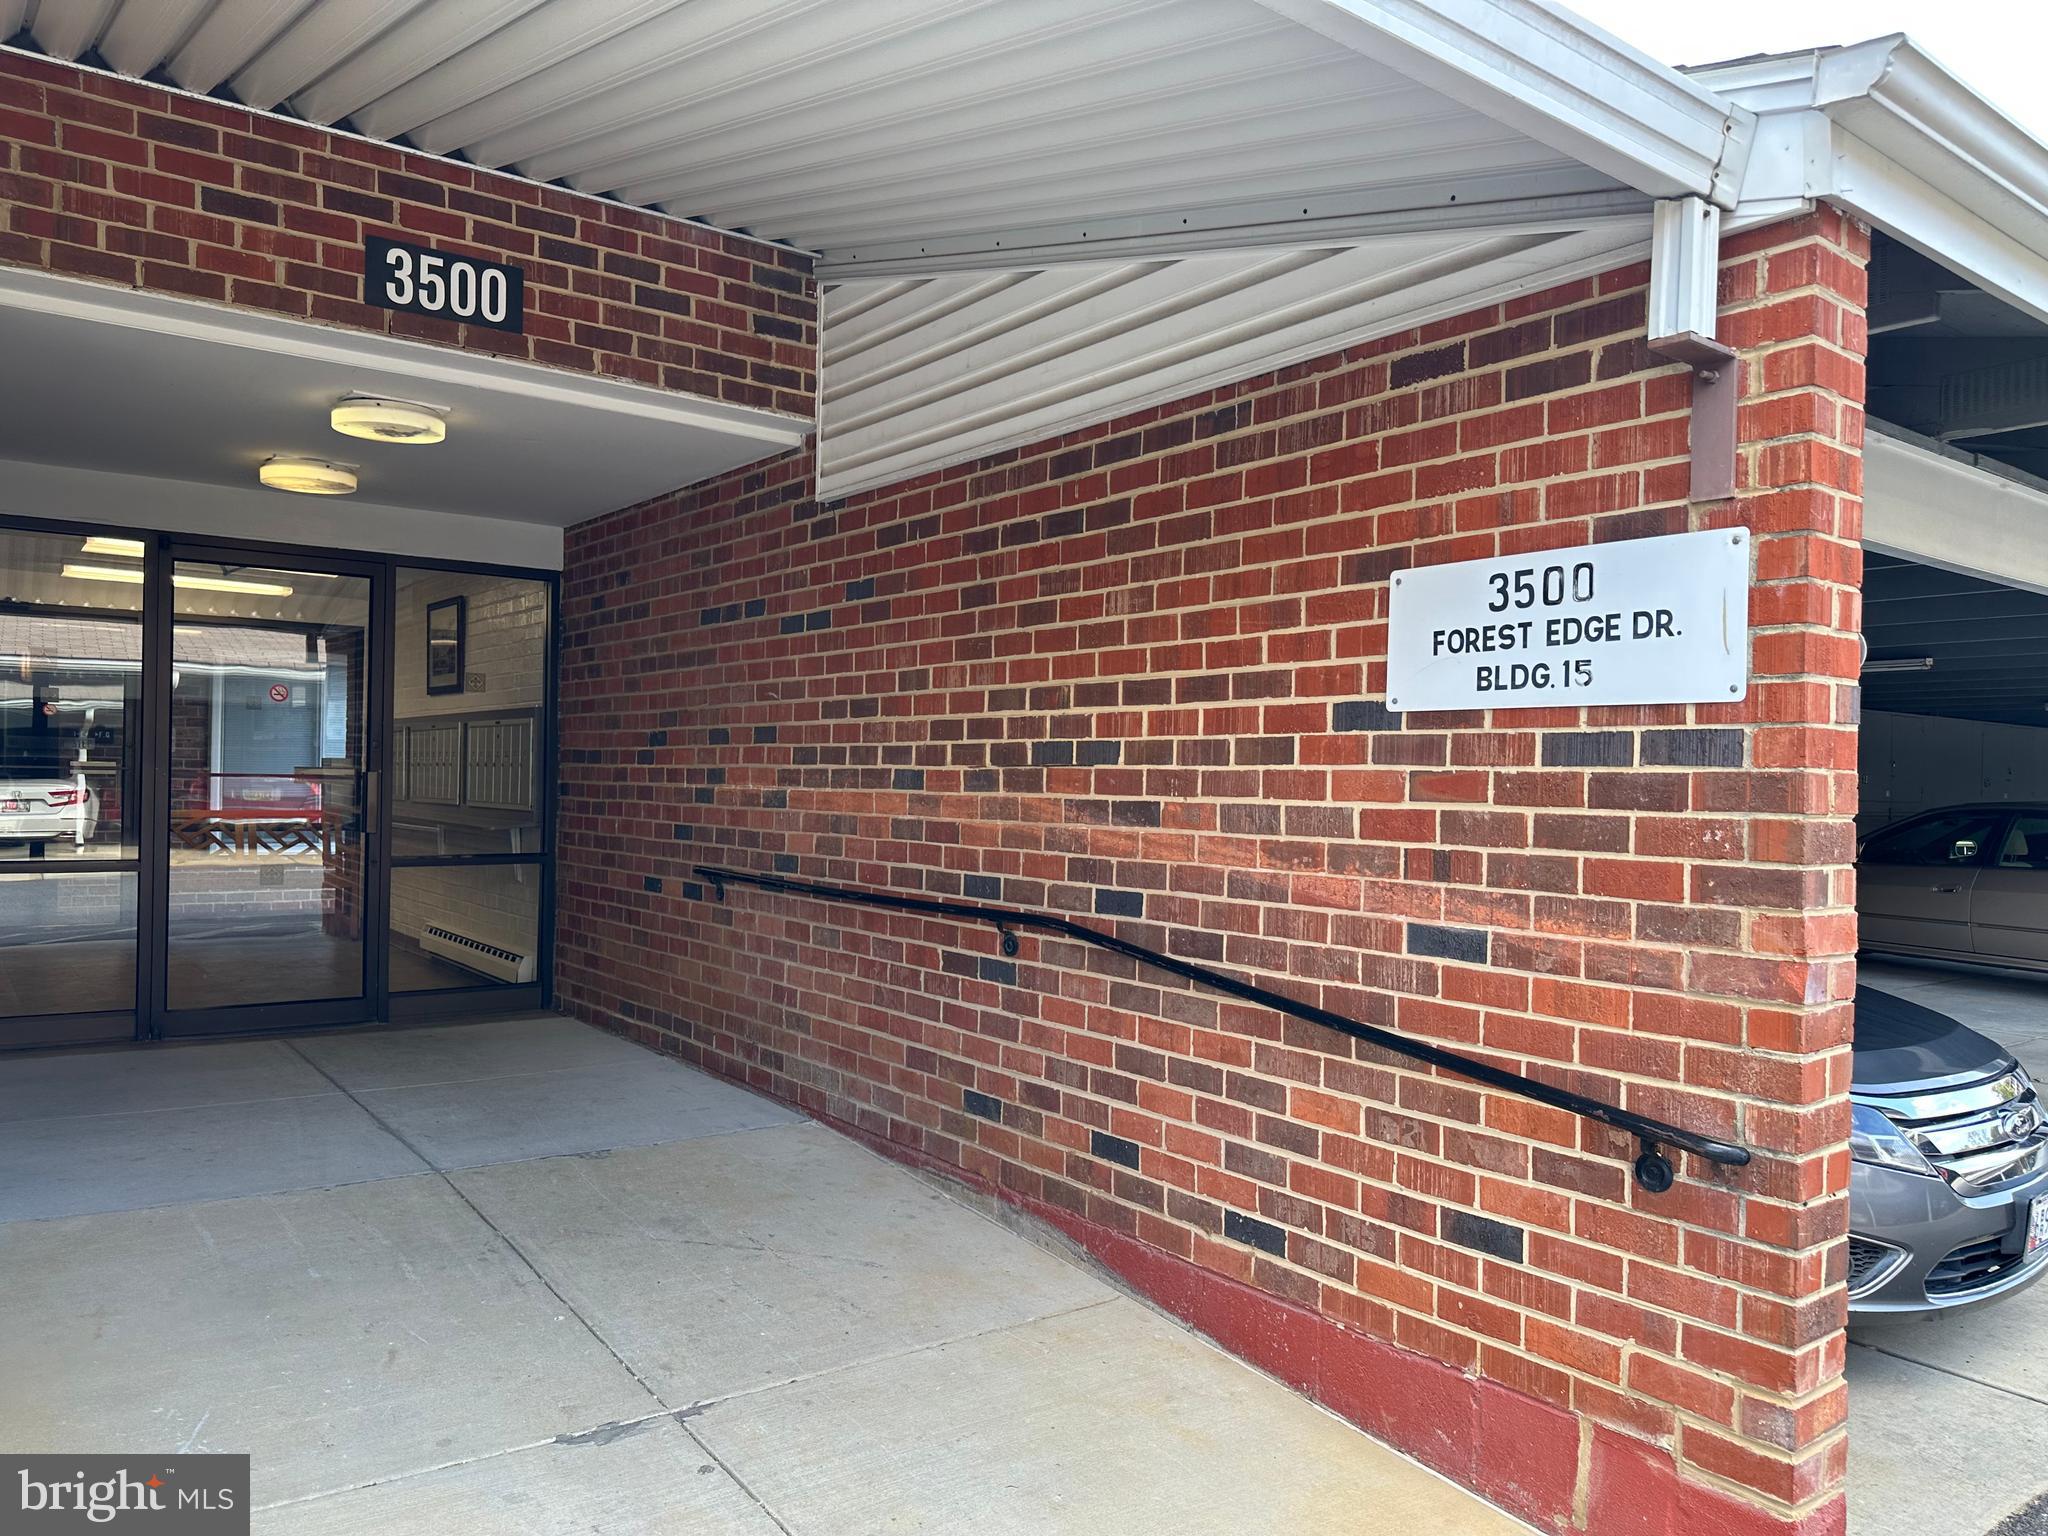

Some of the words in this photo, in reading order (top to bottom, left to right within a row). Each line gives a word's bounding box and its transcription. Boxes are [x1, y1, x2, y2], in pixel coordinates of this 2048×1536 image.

[385, 247, 507, 323] 3500
[1487, 561, 1595, 613] 3500
[1432, 621, 1533, 657] FOREST
[1545, 613, 1622, 647] EDGE
[1632, 609, 1683, 640] DR.
